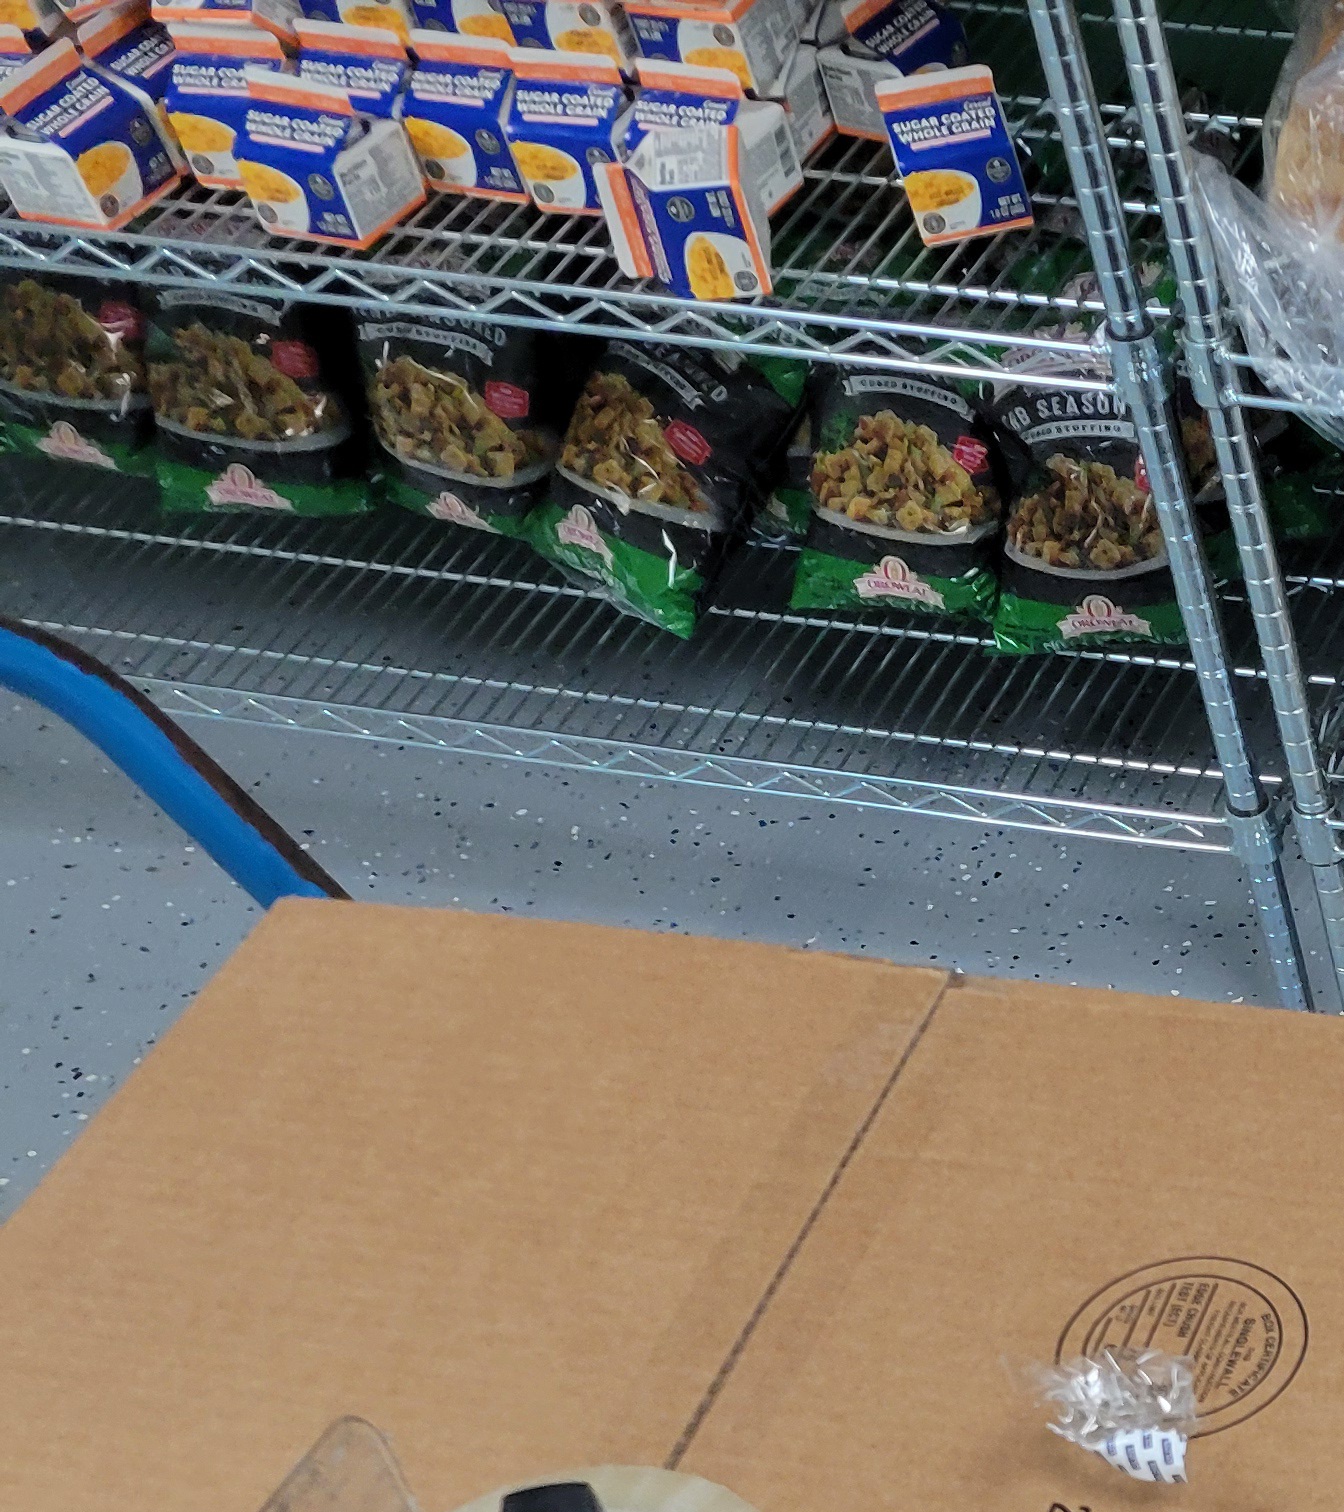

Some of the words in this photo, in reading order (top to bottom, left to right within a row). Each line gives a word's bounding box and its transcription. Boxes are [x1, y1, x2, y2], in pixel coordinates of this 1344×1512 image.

[516, 89, 560, 103] SUGAR
[561, 93, 615, 108] COATED
[516, 101, 563, 115] WHOLE
[565, 105, 608, 119] GRAIN
[635, 100, 677, 114] SUGAR
[678, 105, 727, 121] COATED
[891, 115, 940, 134] SUGAR
[940, 106, 997, 127] COATED
[896, 124, 951, 146] WHOLE
[951, 117, 997, 137] GRAIN
[1035, 390, 1127, 420] SEASON
[1215, 1317, 1257, 1390] SINGLEWALL
[1228, 1335, 1277, 1399] CERTIFICATE
